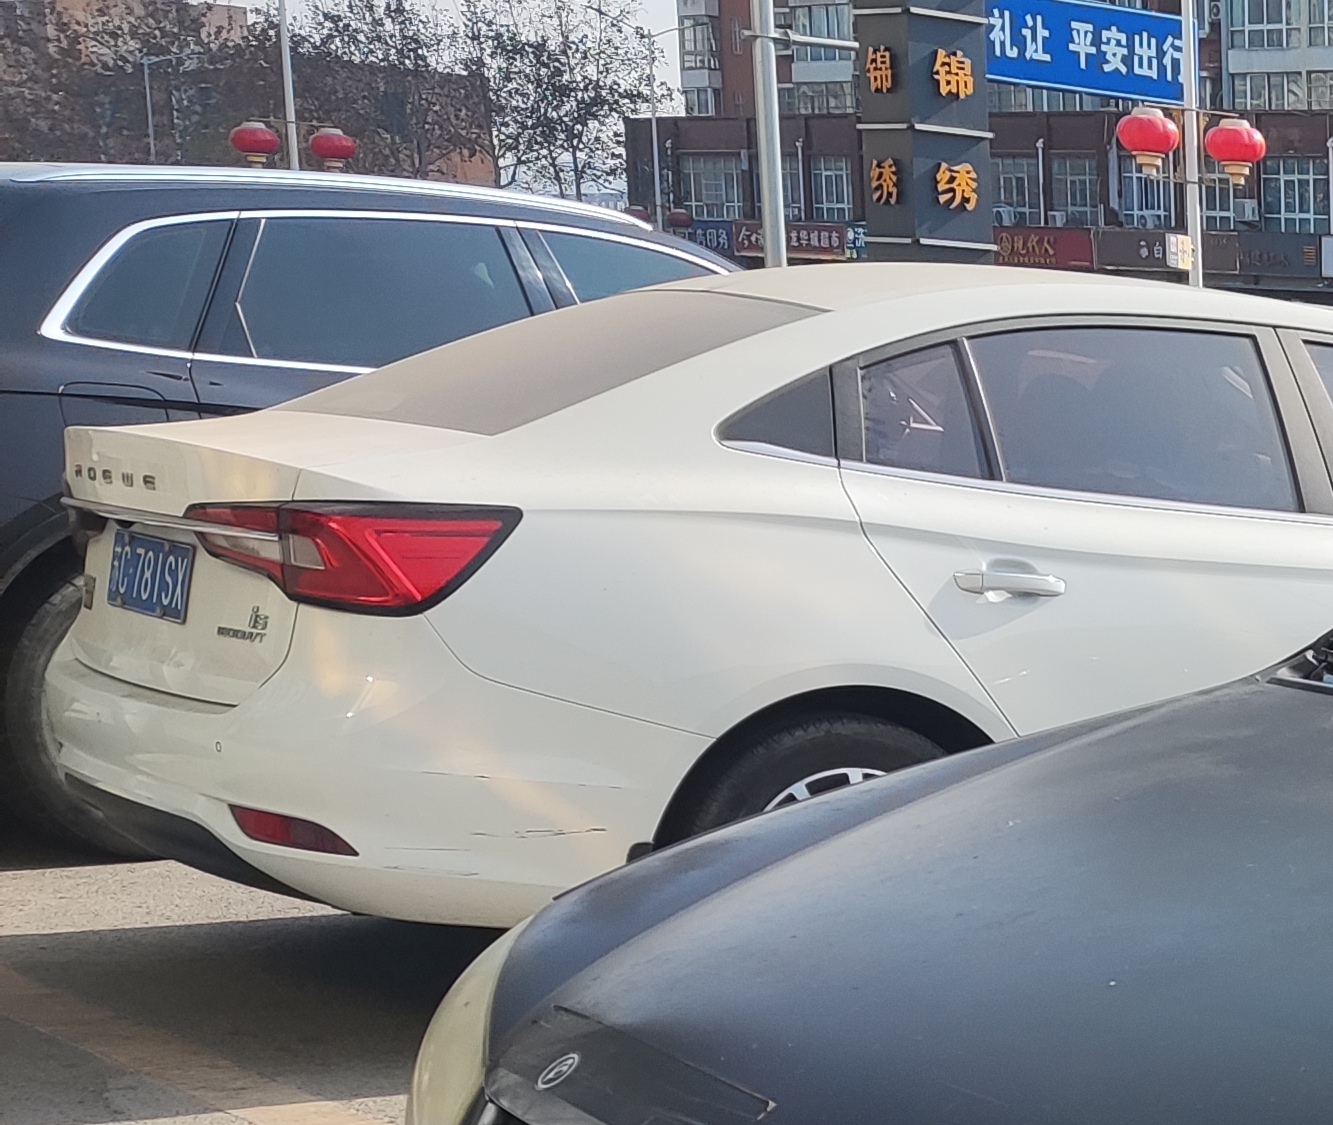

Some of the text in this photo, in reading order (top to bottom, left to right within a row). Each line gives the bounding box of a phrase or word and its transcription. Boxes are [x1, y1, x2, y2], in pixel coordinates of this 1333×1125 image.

[989, 8, 1183, 83] 礼让 平安出行
[932, 48, 979, 212] 锦绣
